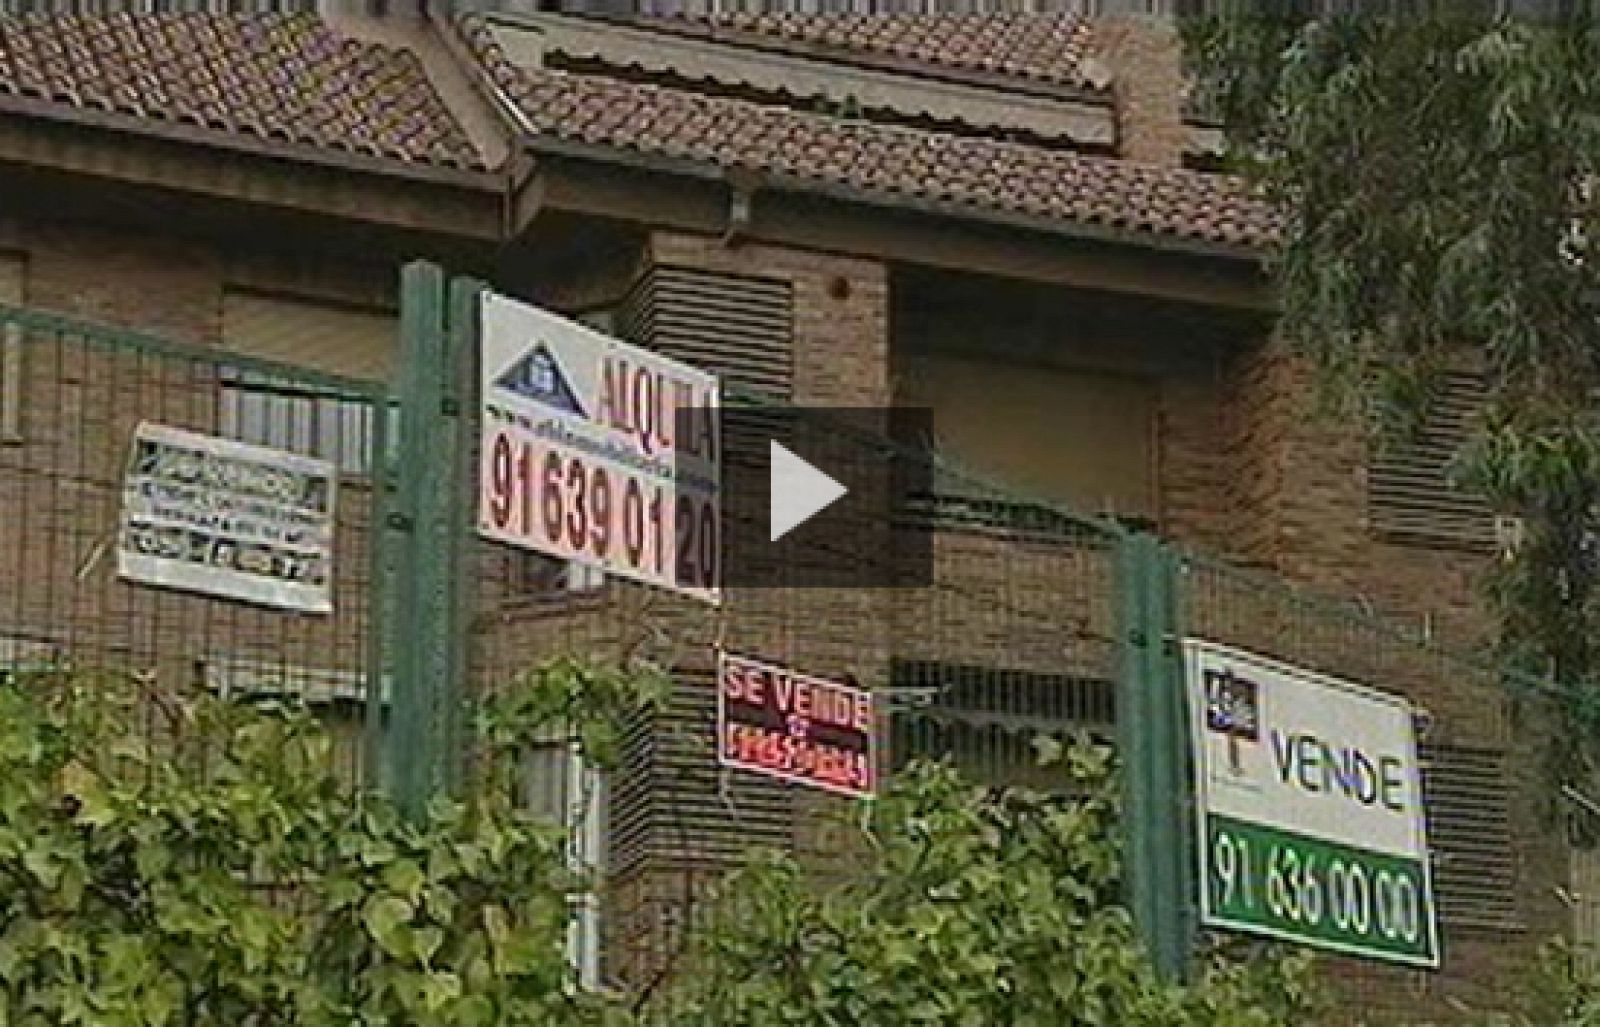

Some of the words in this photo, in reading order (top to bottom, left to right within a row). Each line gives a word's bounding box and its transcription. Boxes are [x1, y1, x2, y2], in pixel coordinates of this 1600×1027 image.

[598, 356, 714, 465] ALQUILA
[491, 432, 531, 536] 91
[543, 449, 610, 557] 639
[624, 475, 663, 574] 01
[675, 493, 714, 592] 20
[725, 664, 765, 704] SE
[774, 672, 871, 730] VENDE
[1271, 728, 1404, 813] VENDE
[1214, 831, 1254, 909] 91
[1266, 842, 1322, 925] 636
[1329, 858, 1370, 935] 00
[1375, 868, 1419, 943] 00
